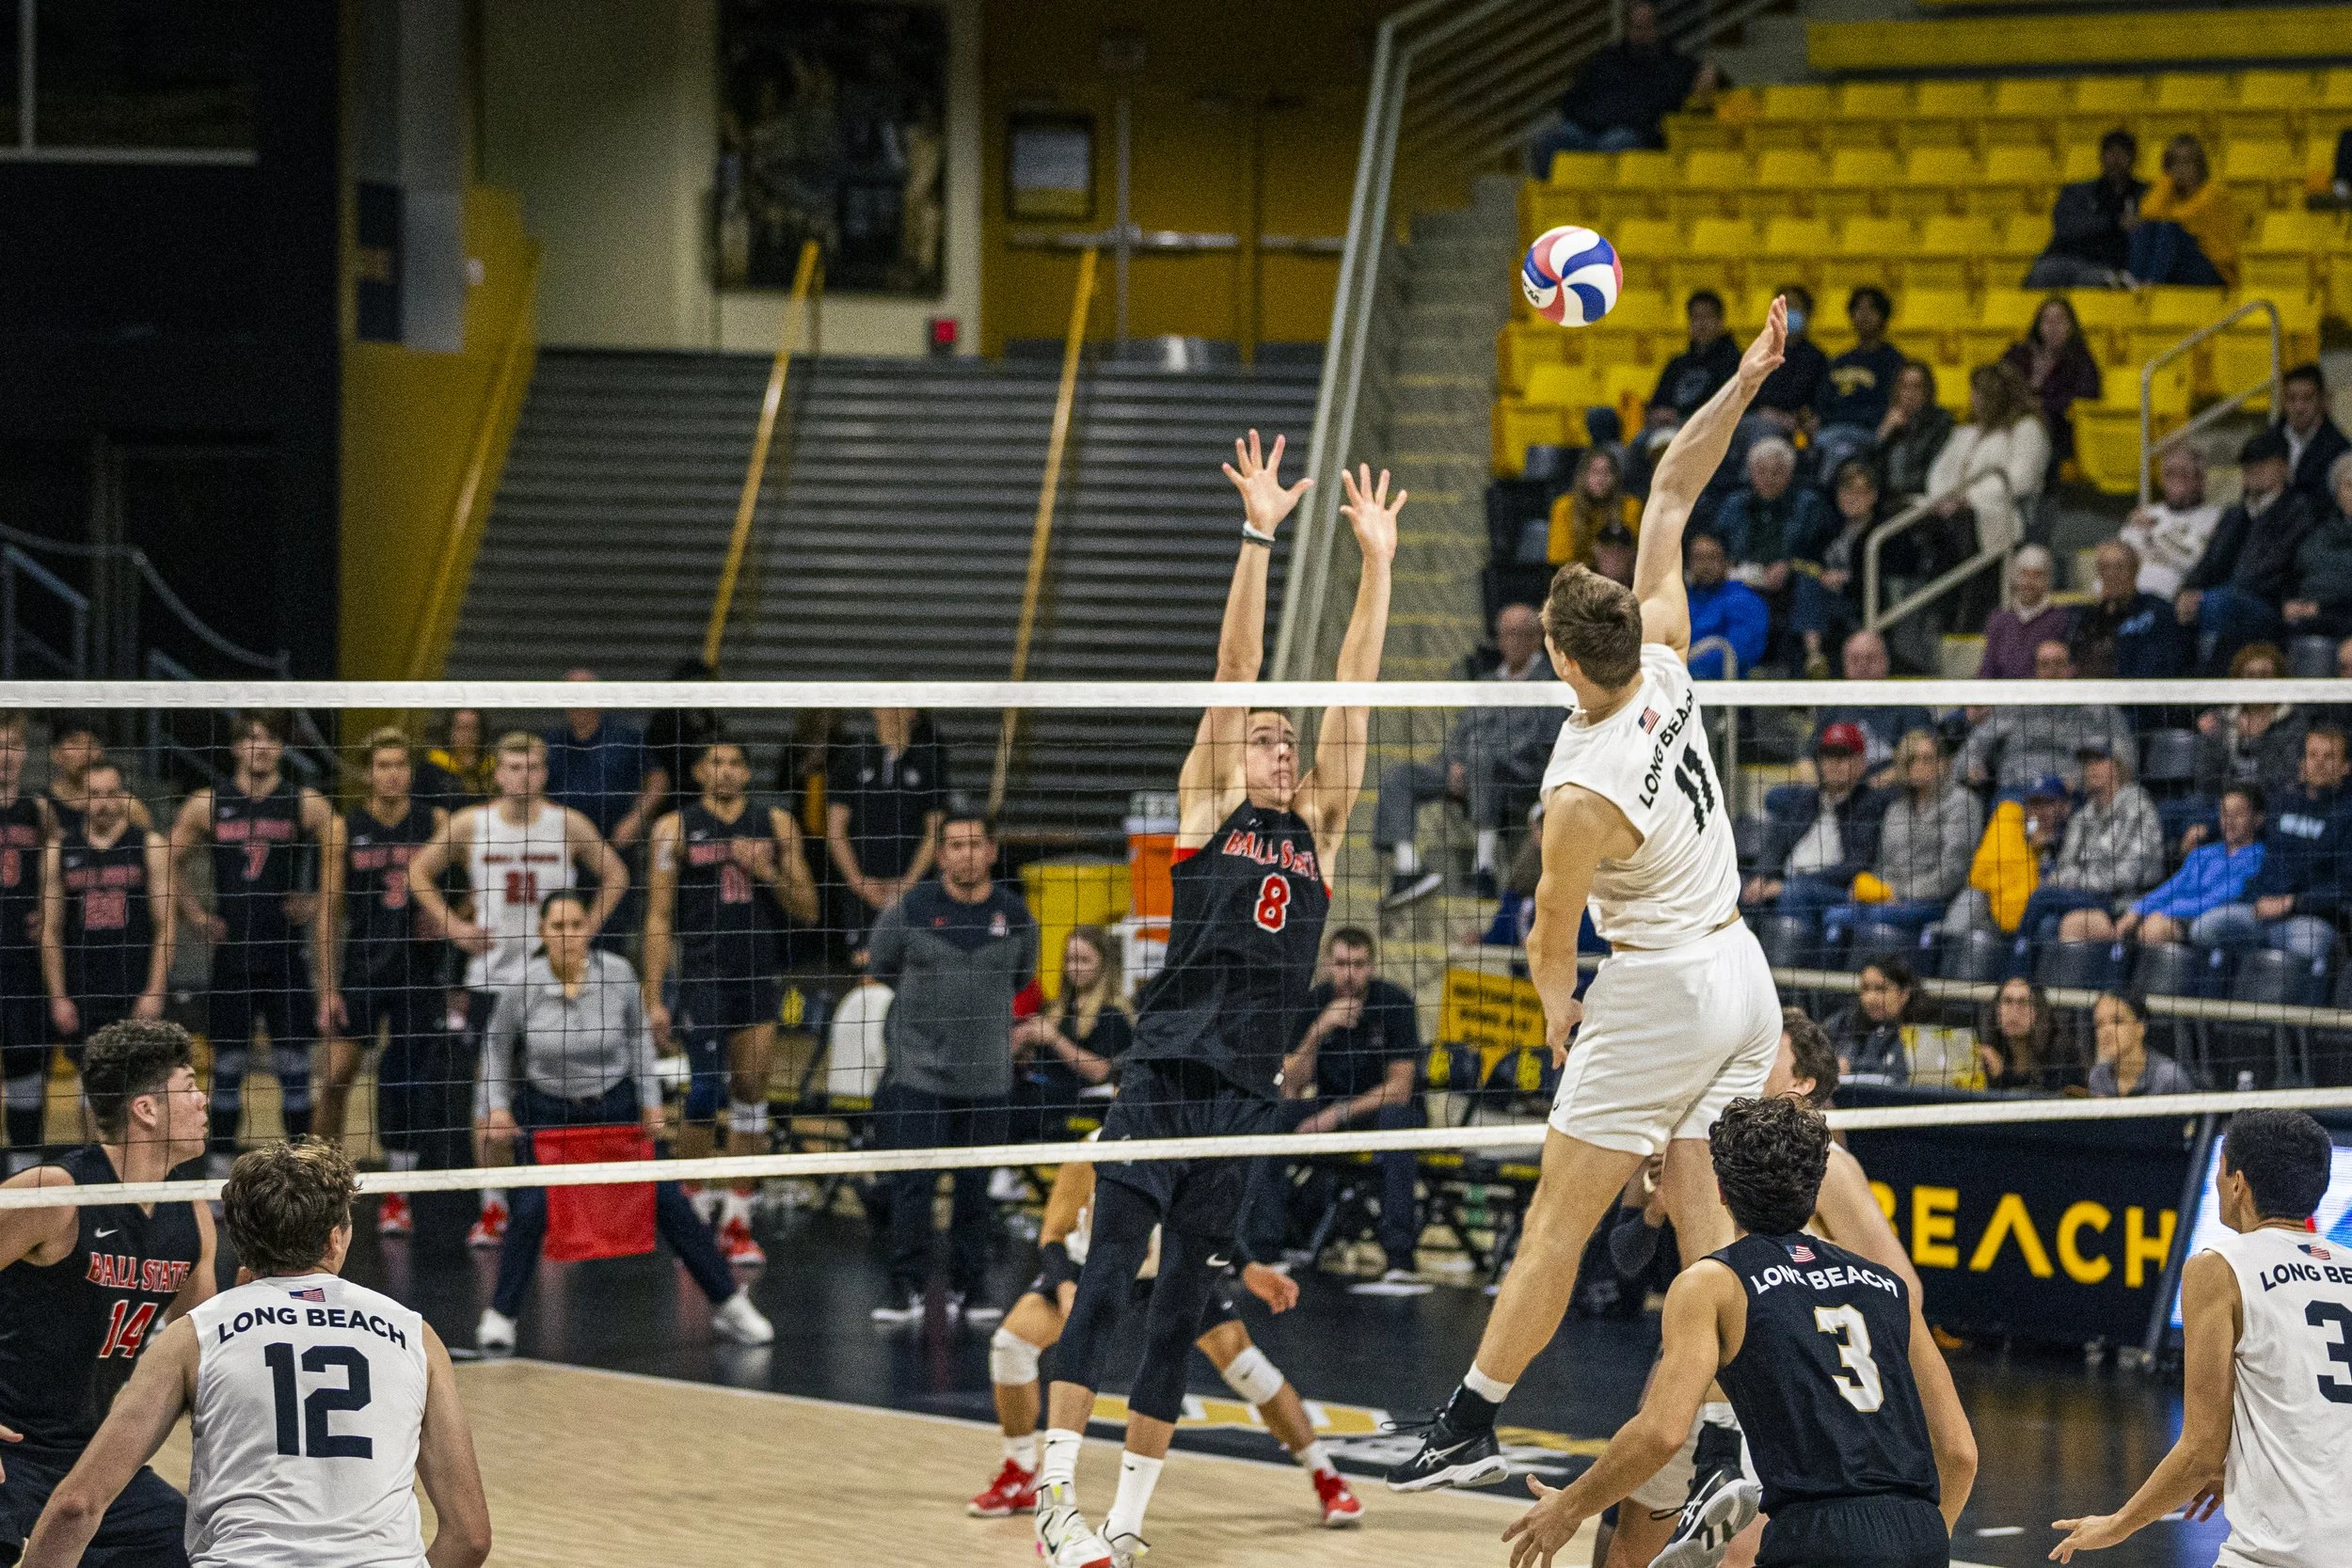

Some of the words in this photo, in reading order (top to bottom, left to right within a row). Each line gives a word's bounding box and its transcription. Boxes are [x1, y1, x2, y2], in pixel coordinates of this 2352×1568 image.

[1639, 744, 1664, 810] LONG
[1675, 742, 1715, 835] 11
[1222, 829, 1279, 865] BALL
[1253, 872, 1292, 933] 8
[86, 1252, 139, 1290] BALL
[141, 1259, 191, 1292] STATE
[1750, 1264, 1808, 1295] LONG
[1805, 1265, 1899, 1298] BEACH
[2259, 1262, 2322, 1292] LONG
[98, 1299, 159, 1358] 14
[218, 1307, 298, 1345] LONG
[306, 1308, 406, 1351] BEACH
[1813, 1303, 1884, 1413] 3
[2304, 1299, 2352, 1404] 3
[263, 1341, 373, 1460] 12
